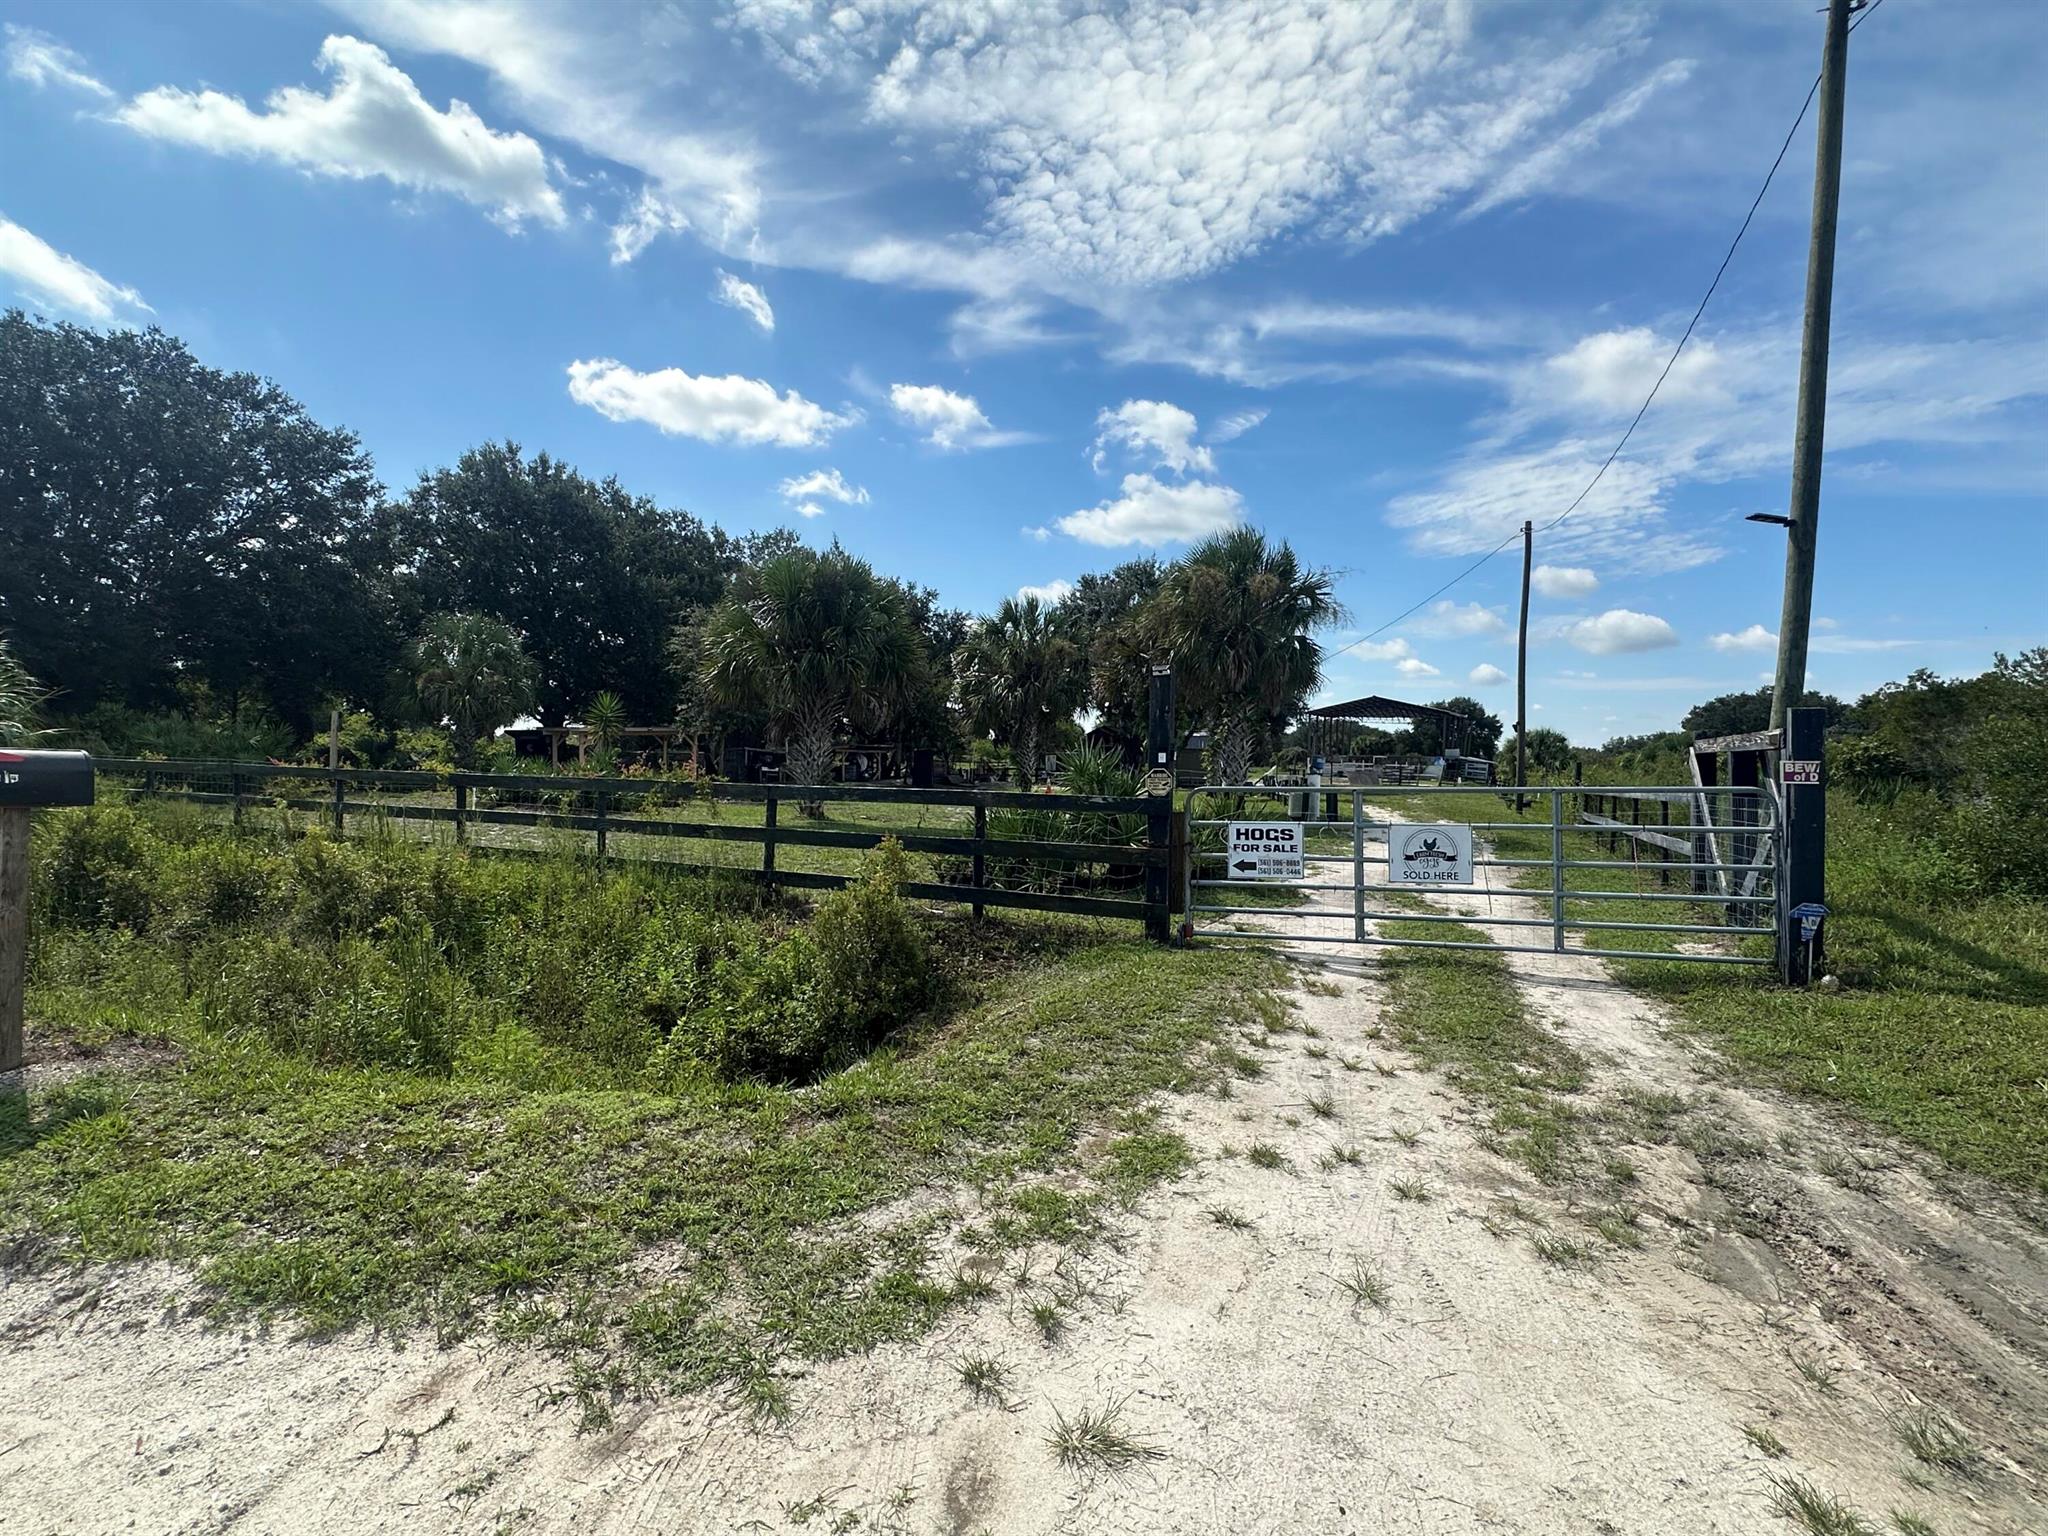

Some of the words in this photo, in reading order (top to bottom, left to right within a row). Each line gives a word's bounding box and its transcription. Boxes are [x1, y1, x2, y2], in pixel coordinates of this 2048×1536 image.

[1793, 772, 1805, 781] of
[1236, 828, 1294, 842] HOGS
[1233, 844, 1260, 853] FOR
[1263, 844, 1299, 853] SALE
[1403, 870, 1430, 880] SOLD
[1434, 871, 1459, 880] HERE
